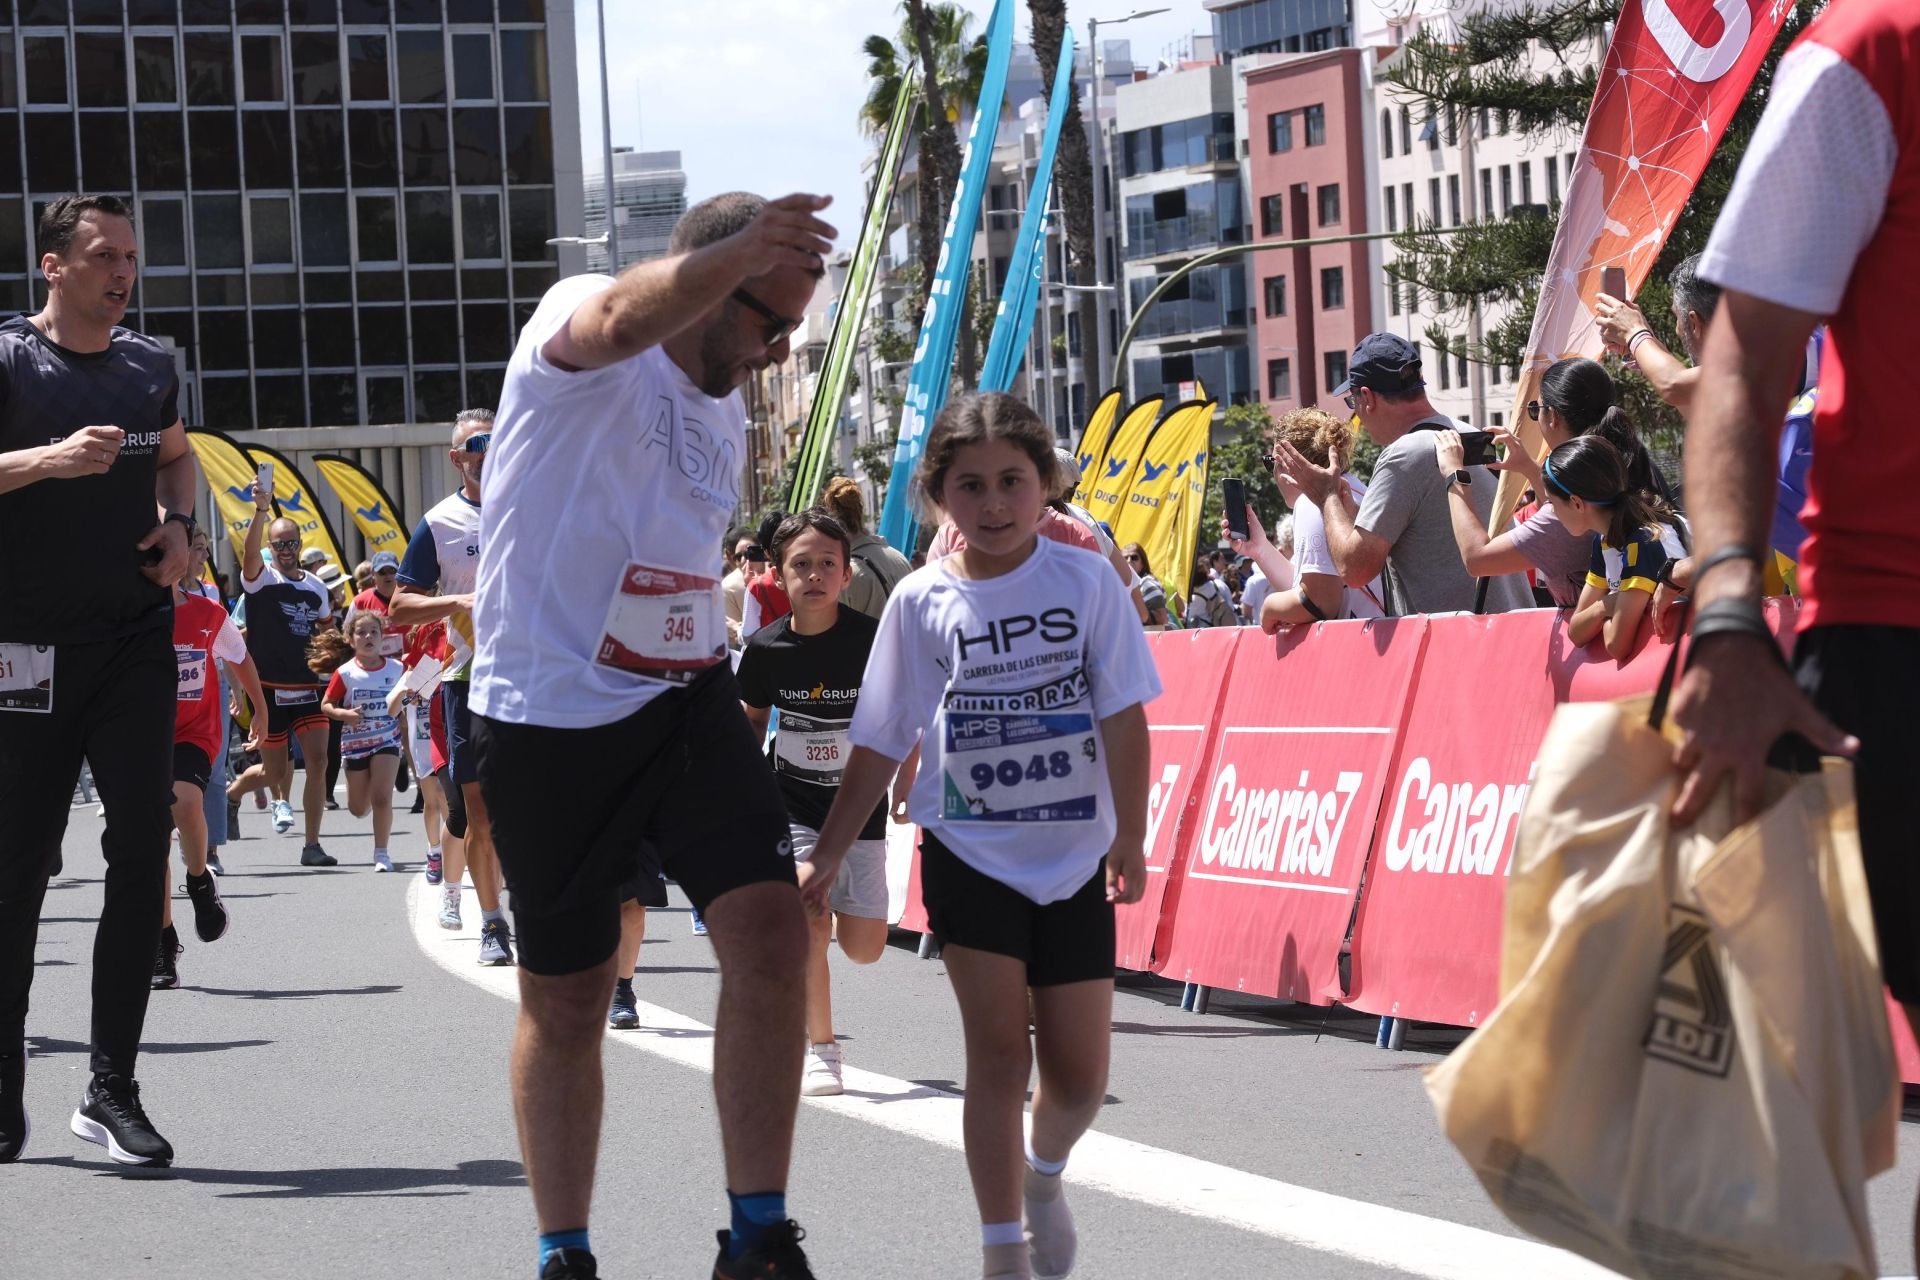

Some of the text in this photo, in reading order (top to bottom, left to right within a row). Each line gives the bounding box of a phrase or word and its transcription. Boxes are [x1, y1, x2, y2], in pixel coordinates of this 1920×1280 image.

[663, 615, 695, 642] 349
[956, 607, 1079, 661] HPS
[963, 649, 1080, 681] CARRERA DE LAS EMPRESAS
[779, 689, 810, 700] FUND
[950, 717, 1002, 738] HPS
[806, 745, 839, 761] 3236
[970, 750, 1072, 792] 9048
[1201, 763, 1363, 878] Canarias7
